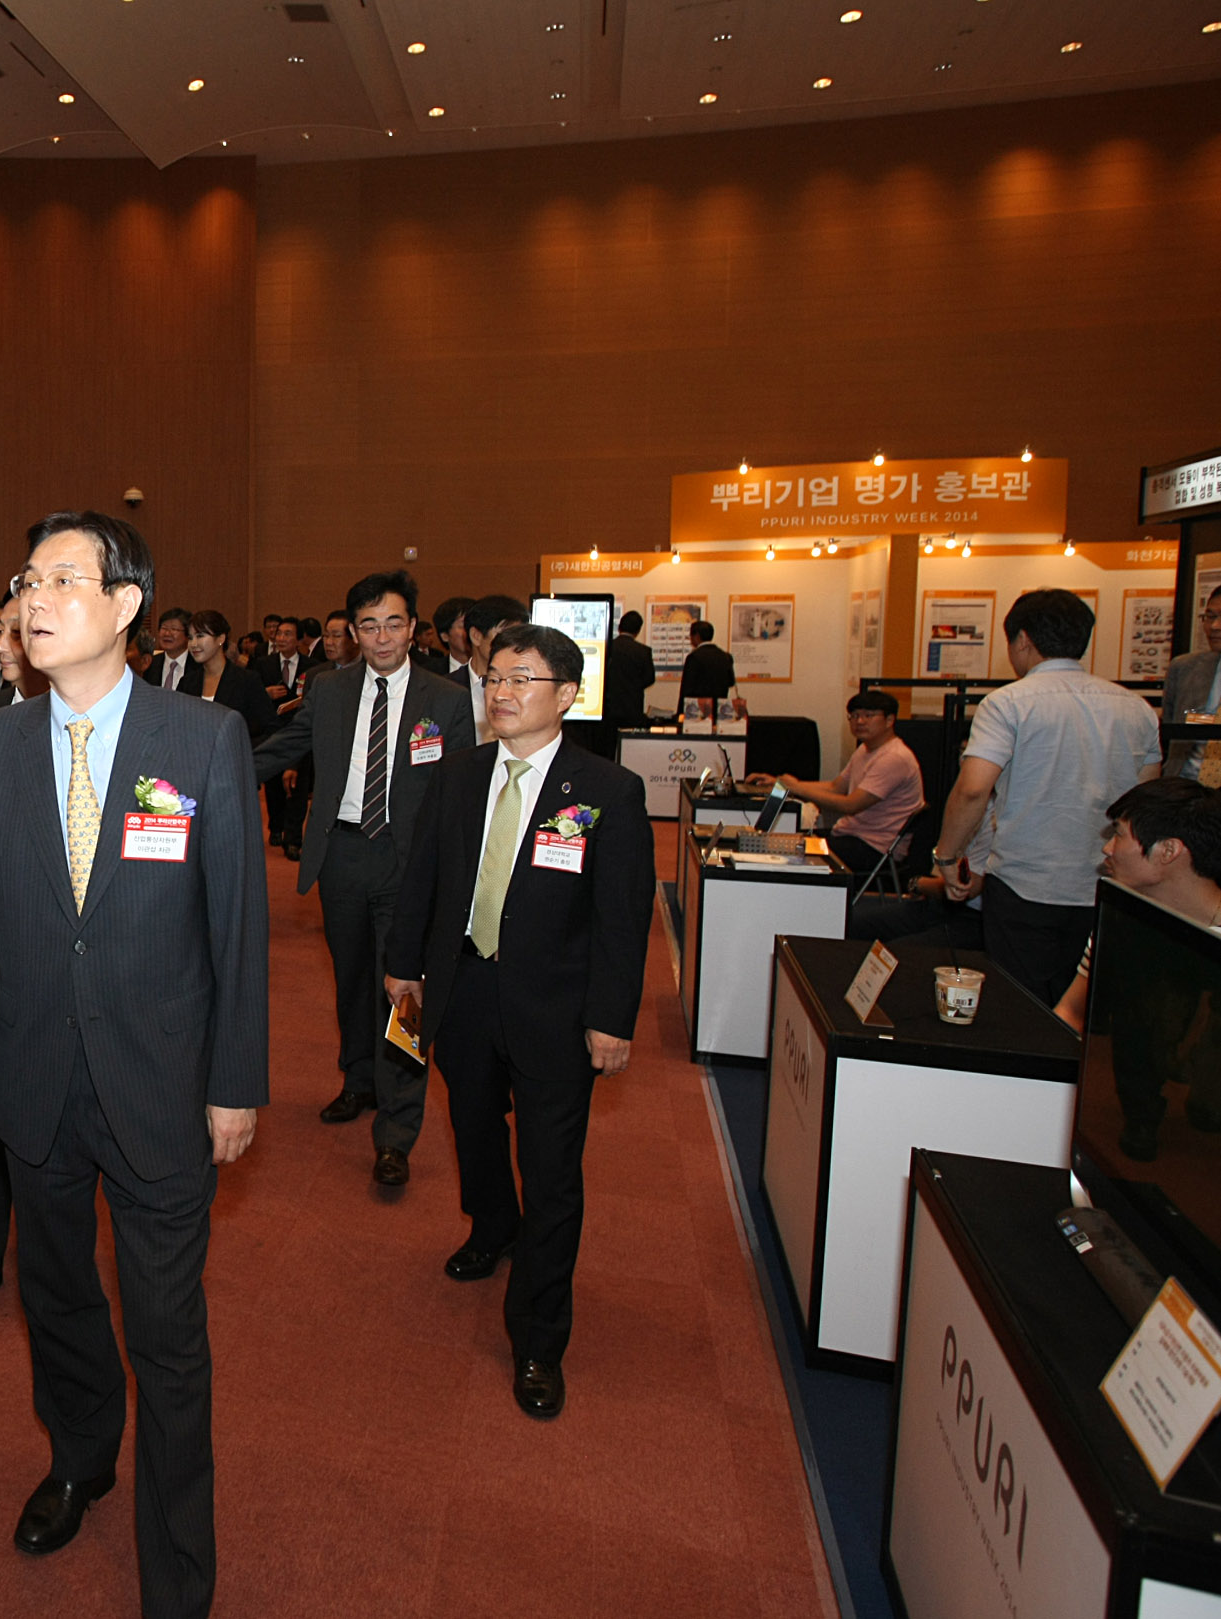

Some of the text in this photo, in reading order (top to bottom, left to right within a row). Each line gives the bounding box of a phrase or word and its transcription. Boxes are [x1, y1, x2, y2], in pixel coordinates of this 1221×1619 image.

[711, 470, 1032, 512] 뿌리기업 명가 홍보관
[760, 510, 979, 529] PPURI INDUSTRY WEEK 2014
[784, 1018, 810, 1105] PPURI
[941, 1325, 1027, 1573] PPURI
